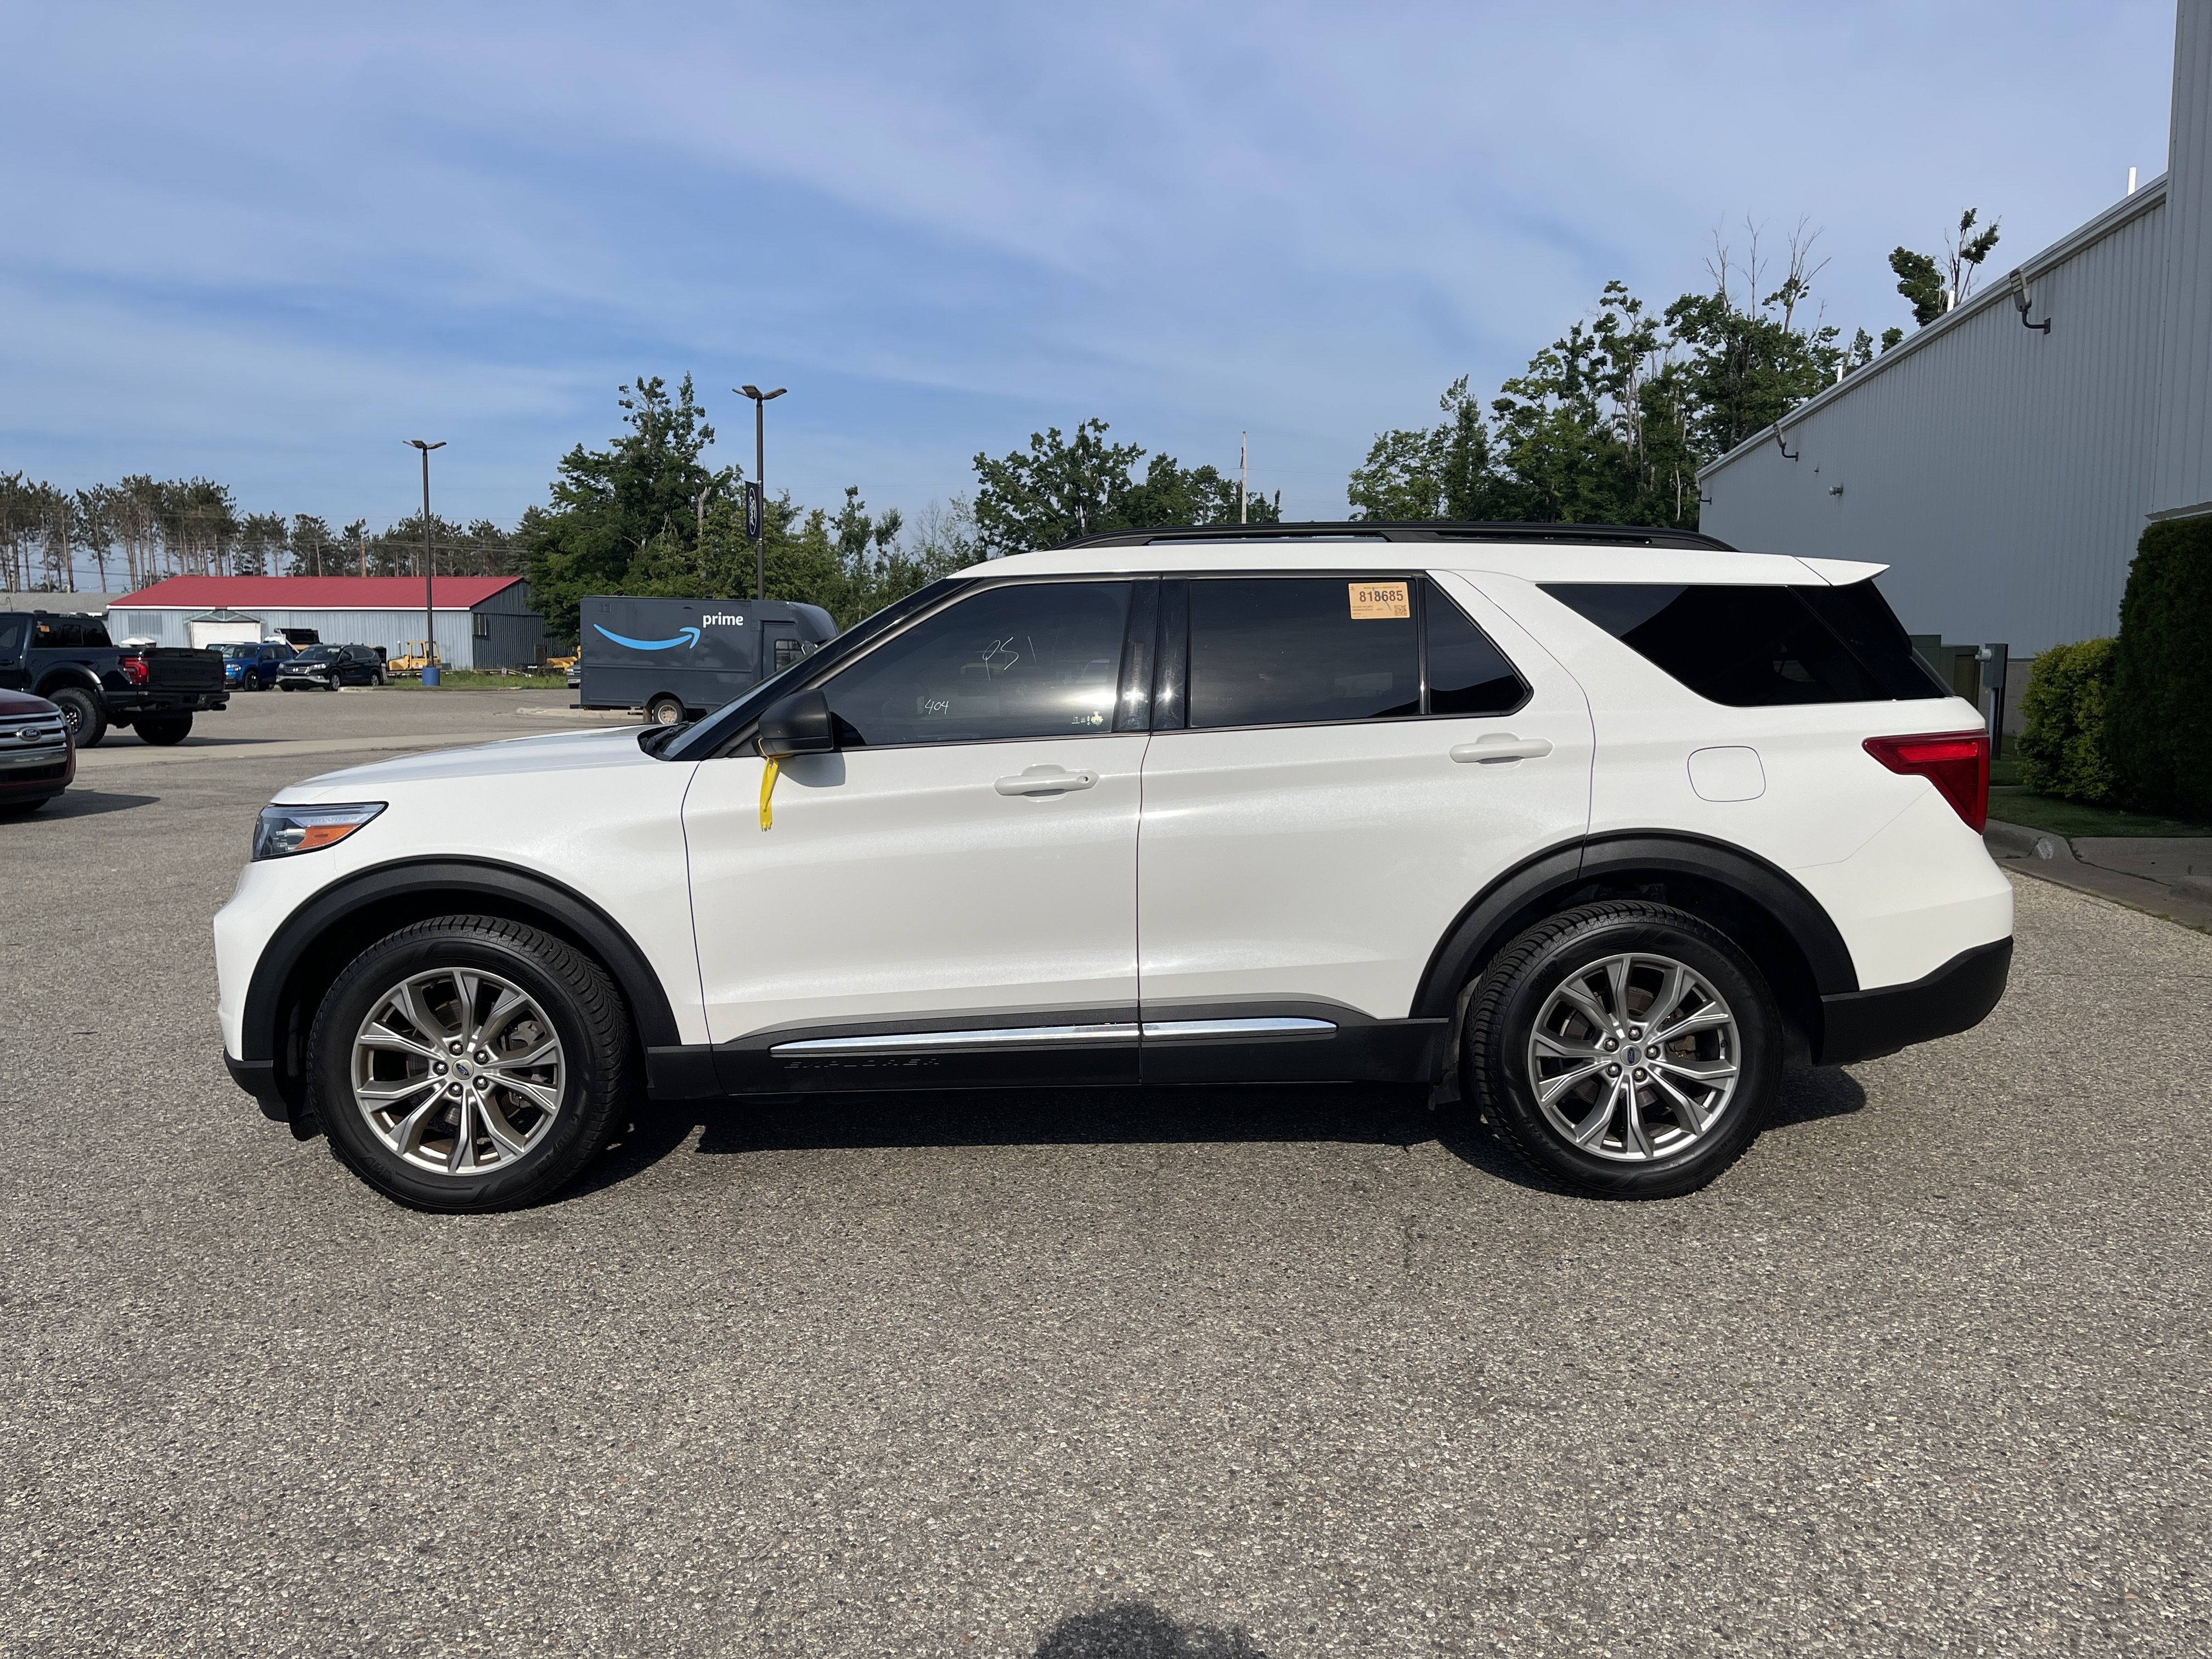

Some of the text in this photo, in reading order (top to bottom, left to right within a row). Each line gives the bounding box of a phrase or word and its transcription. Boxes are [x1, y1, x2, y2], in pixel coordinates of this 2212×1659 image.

[1359, 590, 1403, 602] 818685
[703, 612, 743, 628] prime
[925, 699, 949, 714] 404
